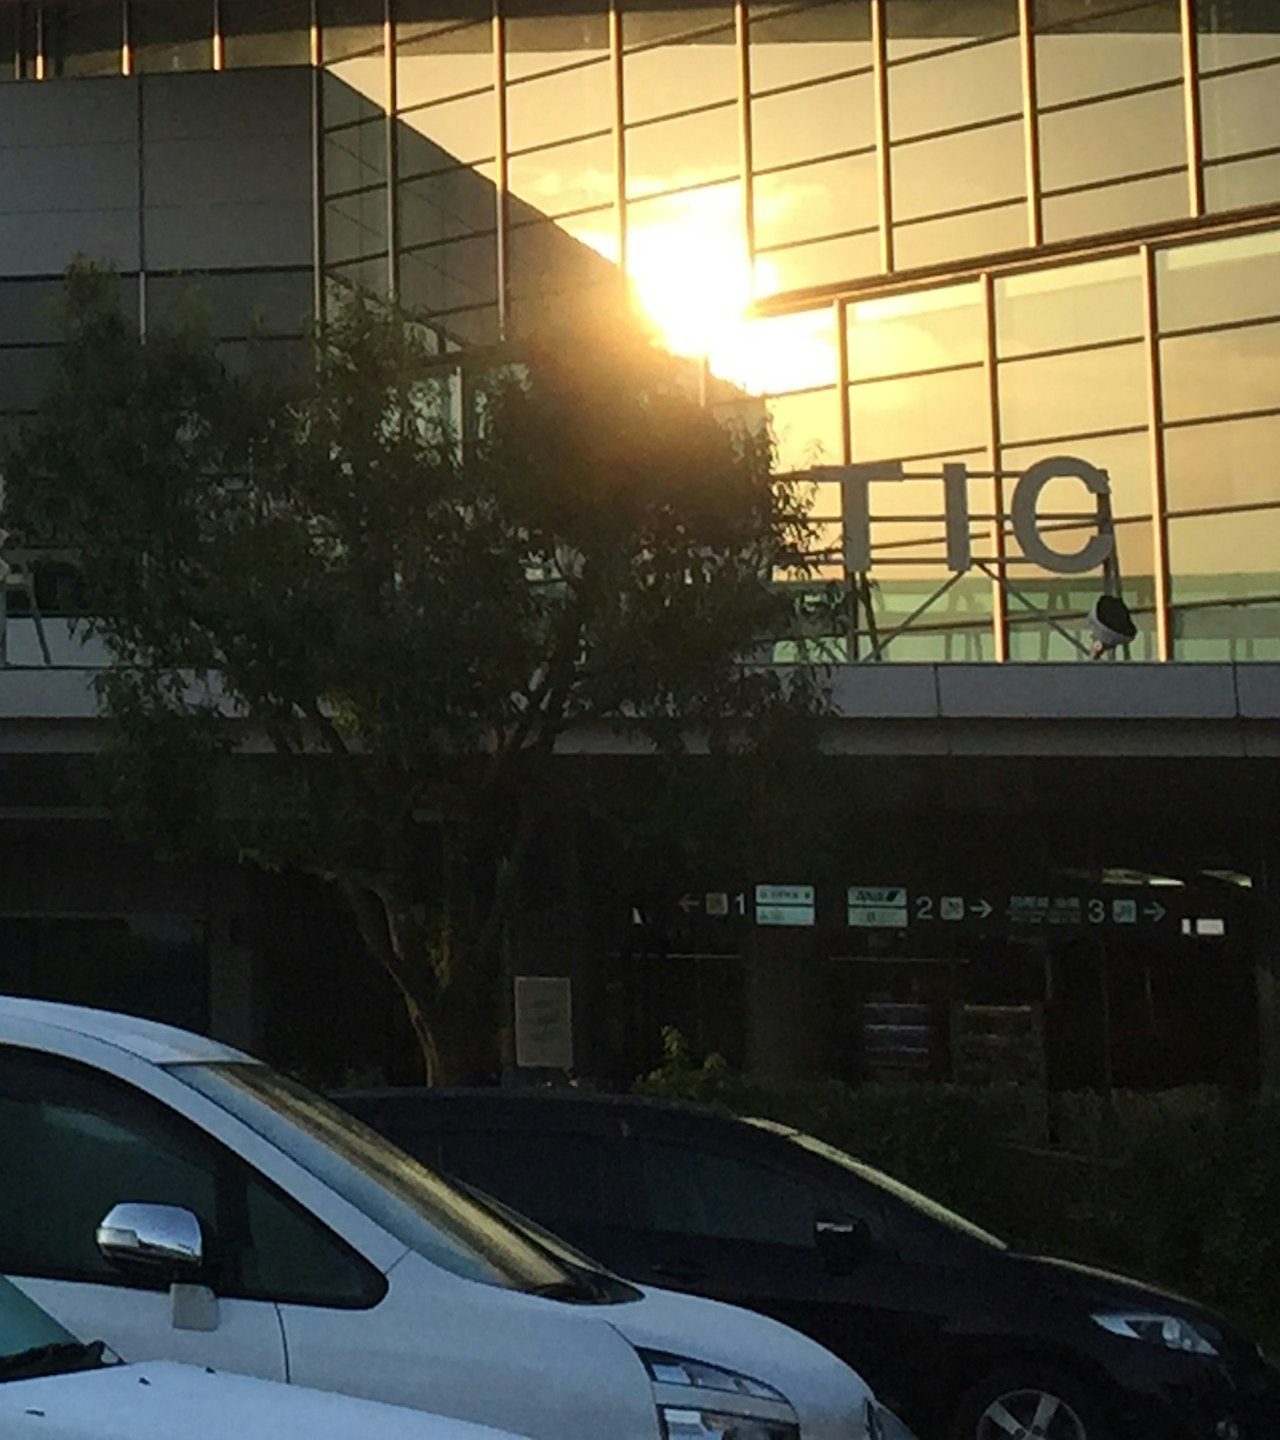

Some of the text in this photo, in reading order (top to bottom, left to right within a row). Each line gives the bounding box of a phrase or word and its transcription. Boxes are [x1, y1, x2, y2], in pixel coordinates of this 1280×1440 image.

[734, 892, 748, 916] 1
[914, 895, 935, 921] 2
[1087, 898, 1107, 924] 3
